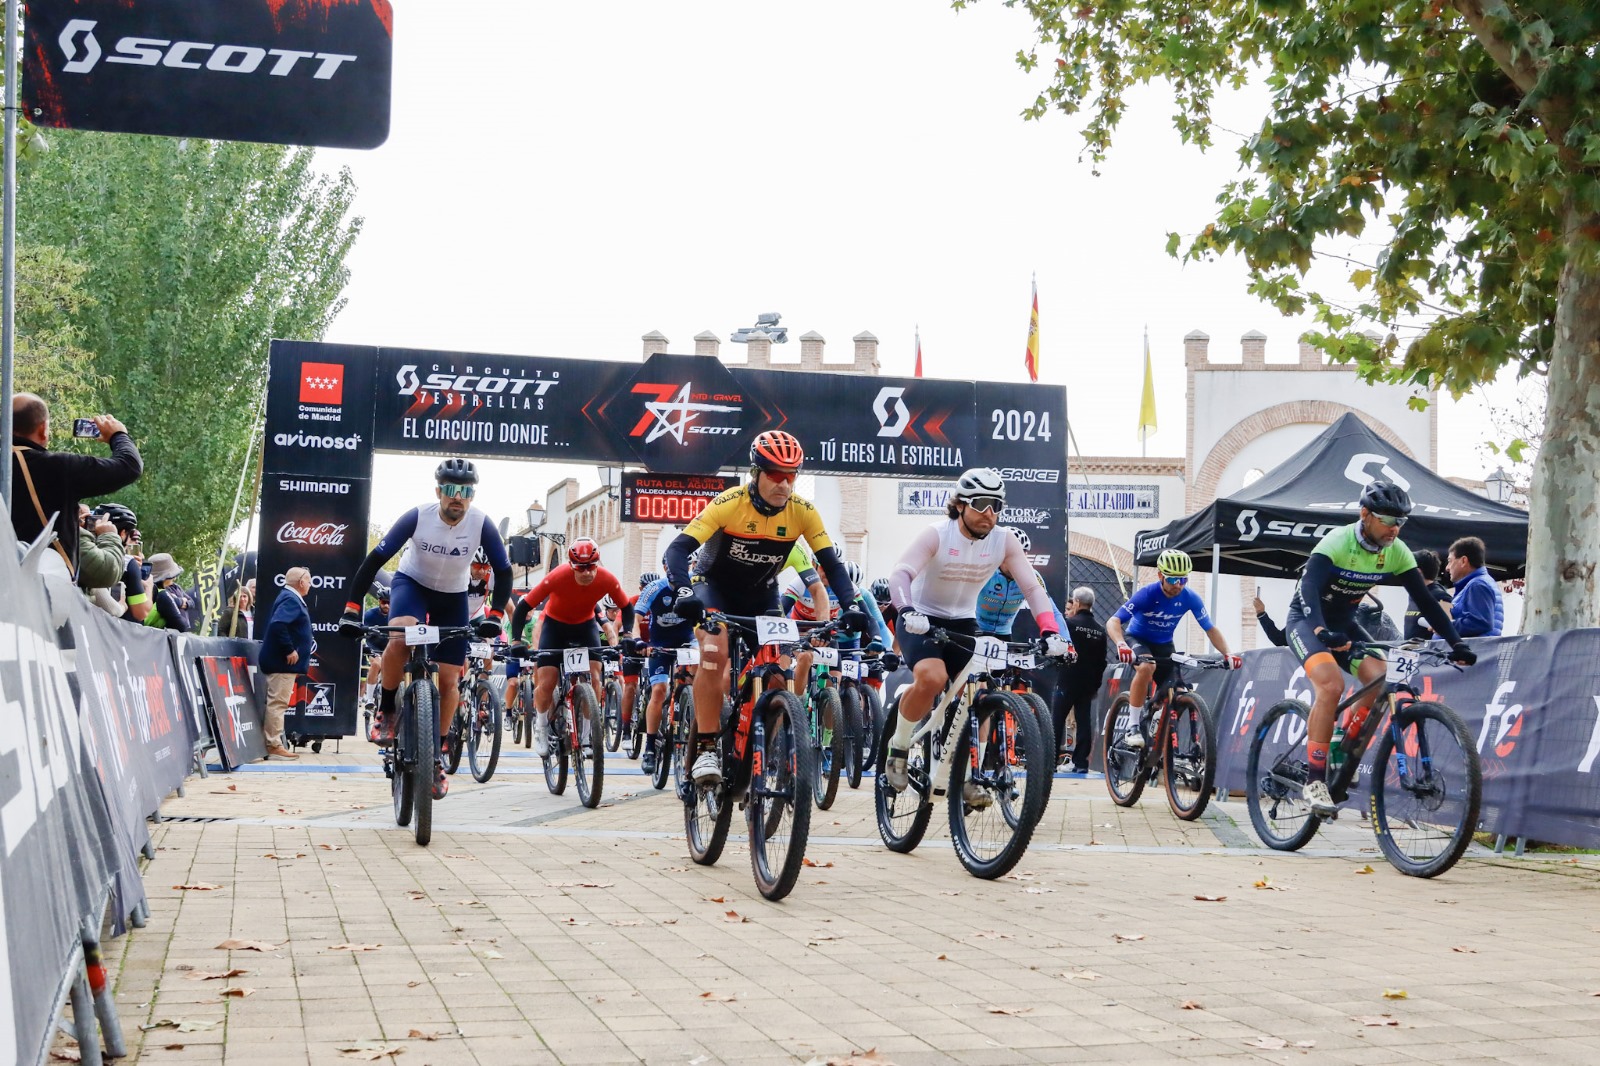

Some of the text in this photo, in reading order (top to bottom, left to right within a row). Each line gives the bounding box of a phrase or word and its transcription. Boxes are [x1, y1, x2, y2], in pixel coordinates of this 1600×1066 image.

[105, 36, 358, 80] SCOTT
[432, 363, 560, 379] CIRCUITO
[421, 374, 560, 396] SCOTT
[420, 391, 544, 411] 7 ESTRELLAS
[713, 394, 743, 402] GRAVEL
[298, 405, 342, 414] Comunidad
[311, 413, 341, 422] Madrid
[403, 417, 420, 439] EL
[425, 418, 494, 443] CIRCUITO
[499, 423, 549, 446] DONDE
[687, 426, 742, 435] SCOTT
[991, 409, 1052, 442] 2024
[274, 430, 359, 450] avimosa
[819, 438, 837, 462] TÚ
[841, 442, 875, 463] ERES
[879, 444, 896, 464] LA
[901, 445, 964, 468] ESTRELLA
[279, 480, 351, 494] SHIMANO
[635, 479, 663, 488] RUTA
[665, 480, 686, 489] DEL
[635, 488, 723, 497] VALDEOLMOS-ALALPARD
[921, 490, 951, 507] PLAZ
[1076, 492, 1135, 510] ALALPARDO
[998, 516, 1042, 524] ENDURANCE
[1263, 520, 1345, 539] SCO
[1142, 534, 1170, 552] SCOTT
[729, 549, 784, 565] CALDERO
[273, 573, 347, 589] GORT
[418, 626, 427, 635] 9
[766, 620, 790, 635] 28
[983, 641, 999, 659] 10
[569, 652, 583, 665] 17
[1014, 659, 1029, 668] 25
[1396, 657, 1413, 674] 24
[843, 663, 854, 673] 32
